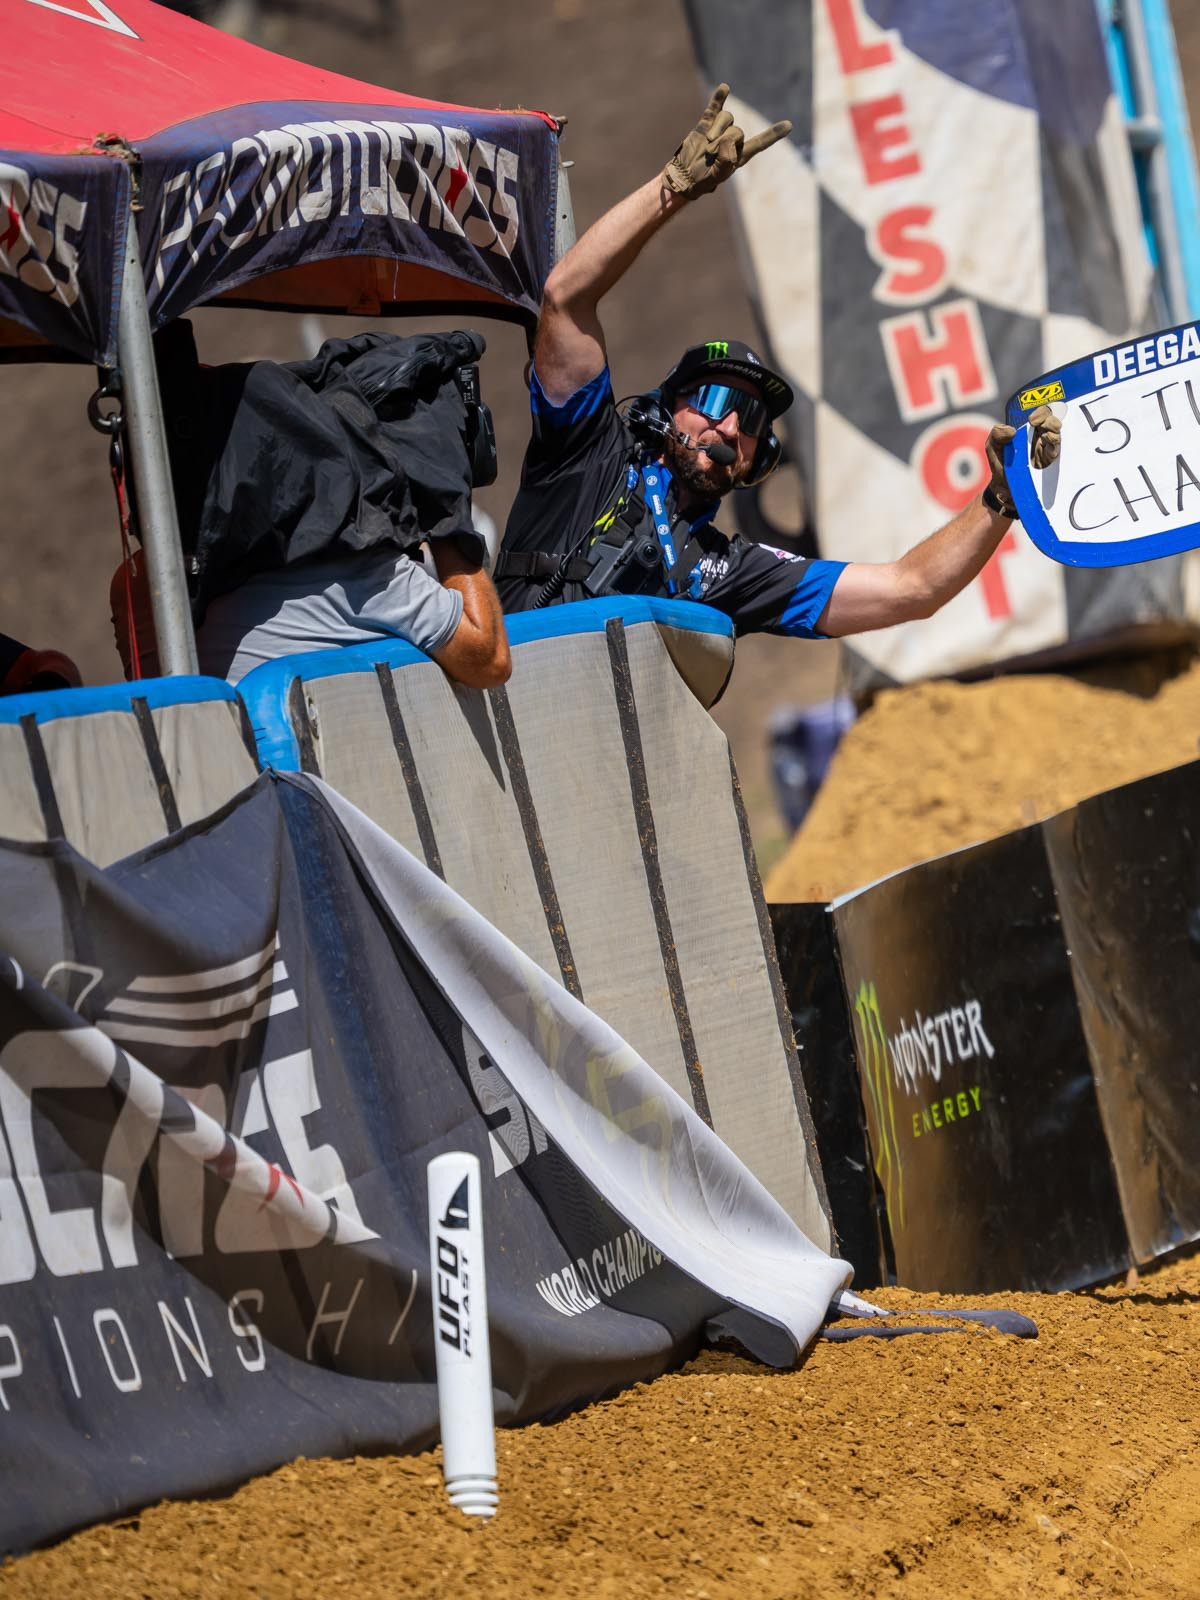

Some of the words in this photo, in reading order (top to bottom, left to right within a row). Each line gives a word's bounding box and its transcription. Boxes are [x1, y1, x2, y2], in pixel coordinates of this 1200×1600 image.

[1079, 394, 1132, 454] 5
[888, 998, 995, 1096] MONSTER
[911, 1085, 982, 1138] ENERGY
[436, 1235, 462, 1351] UFO
[460, 1249, 472, 1358] PLAST
[535, 1257, 600, 1317] WORLD
